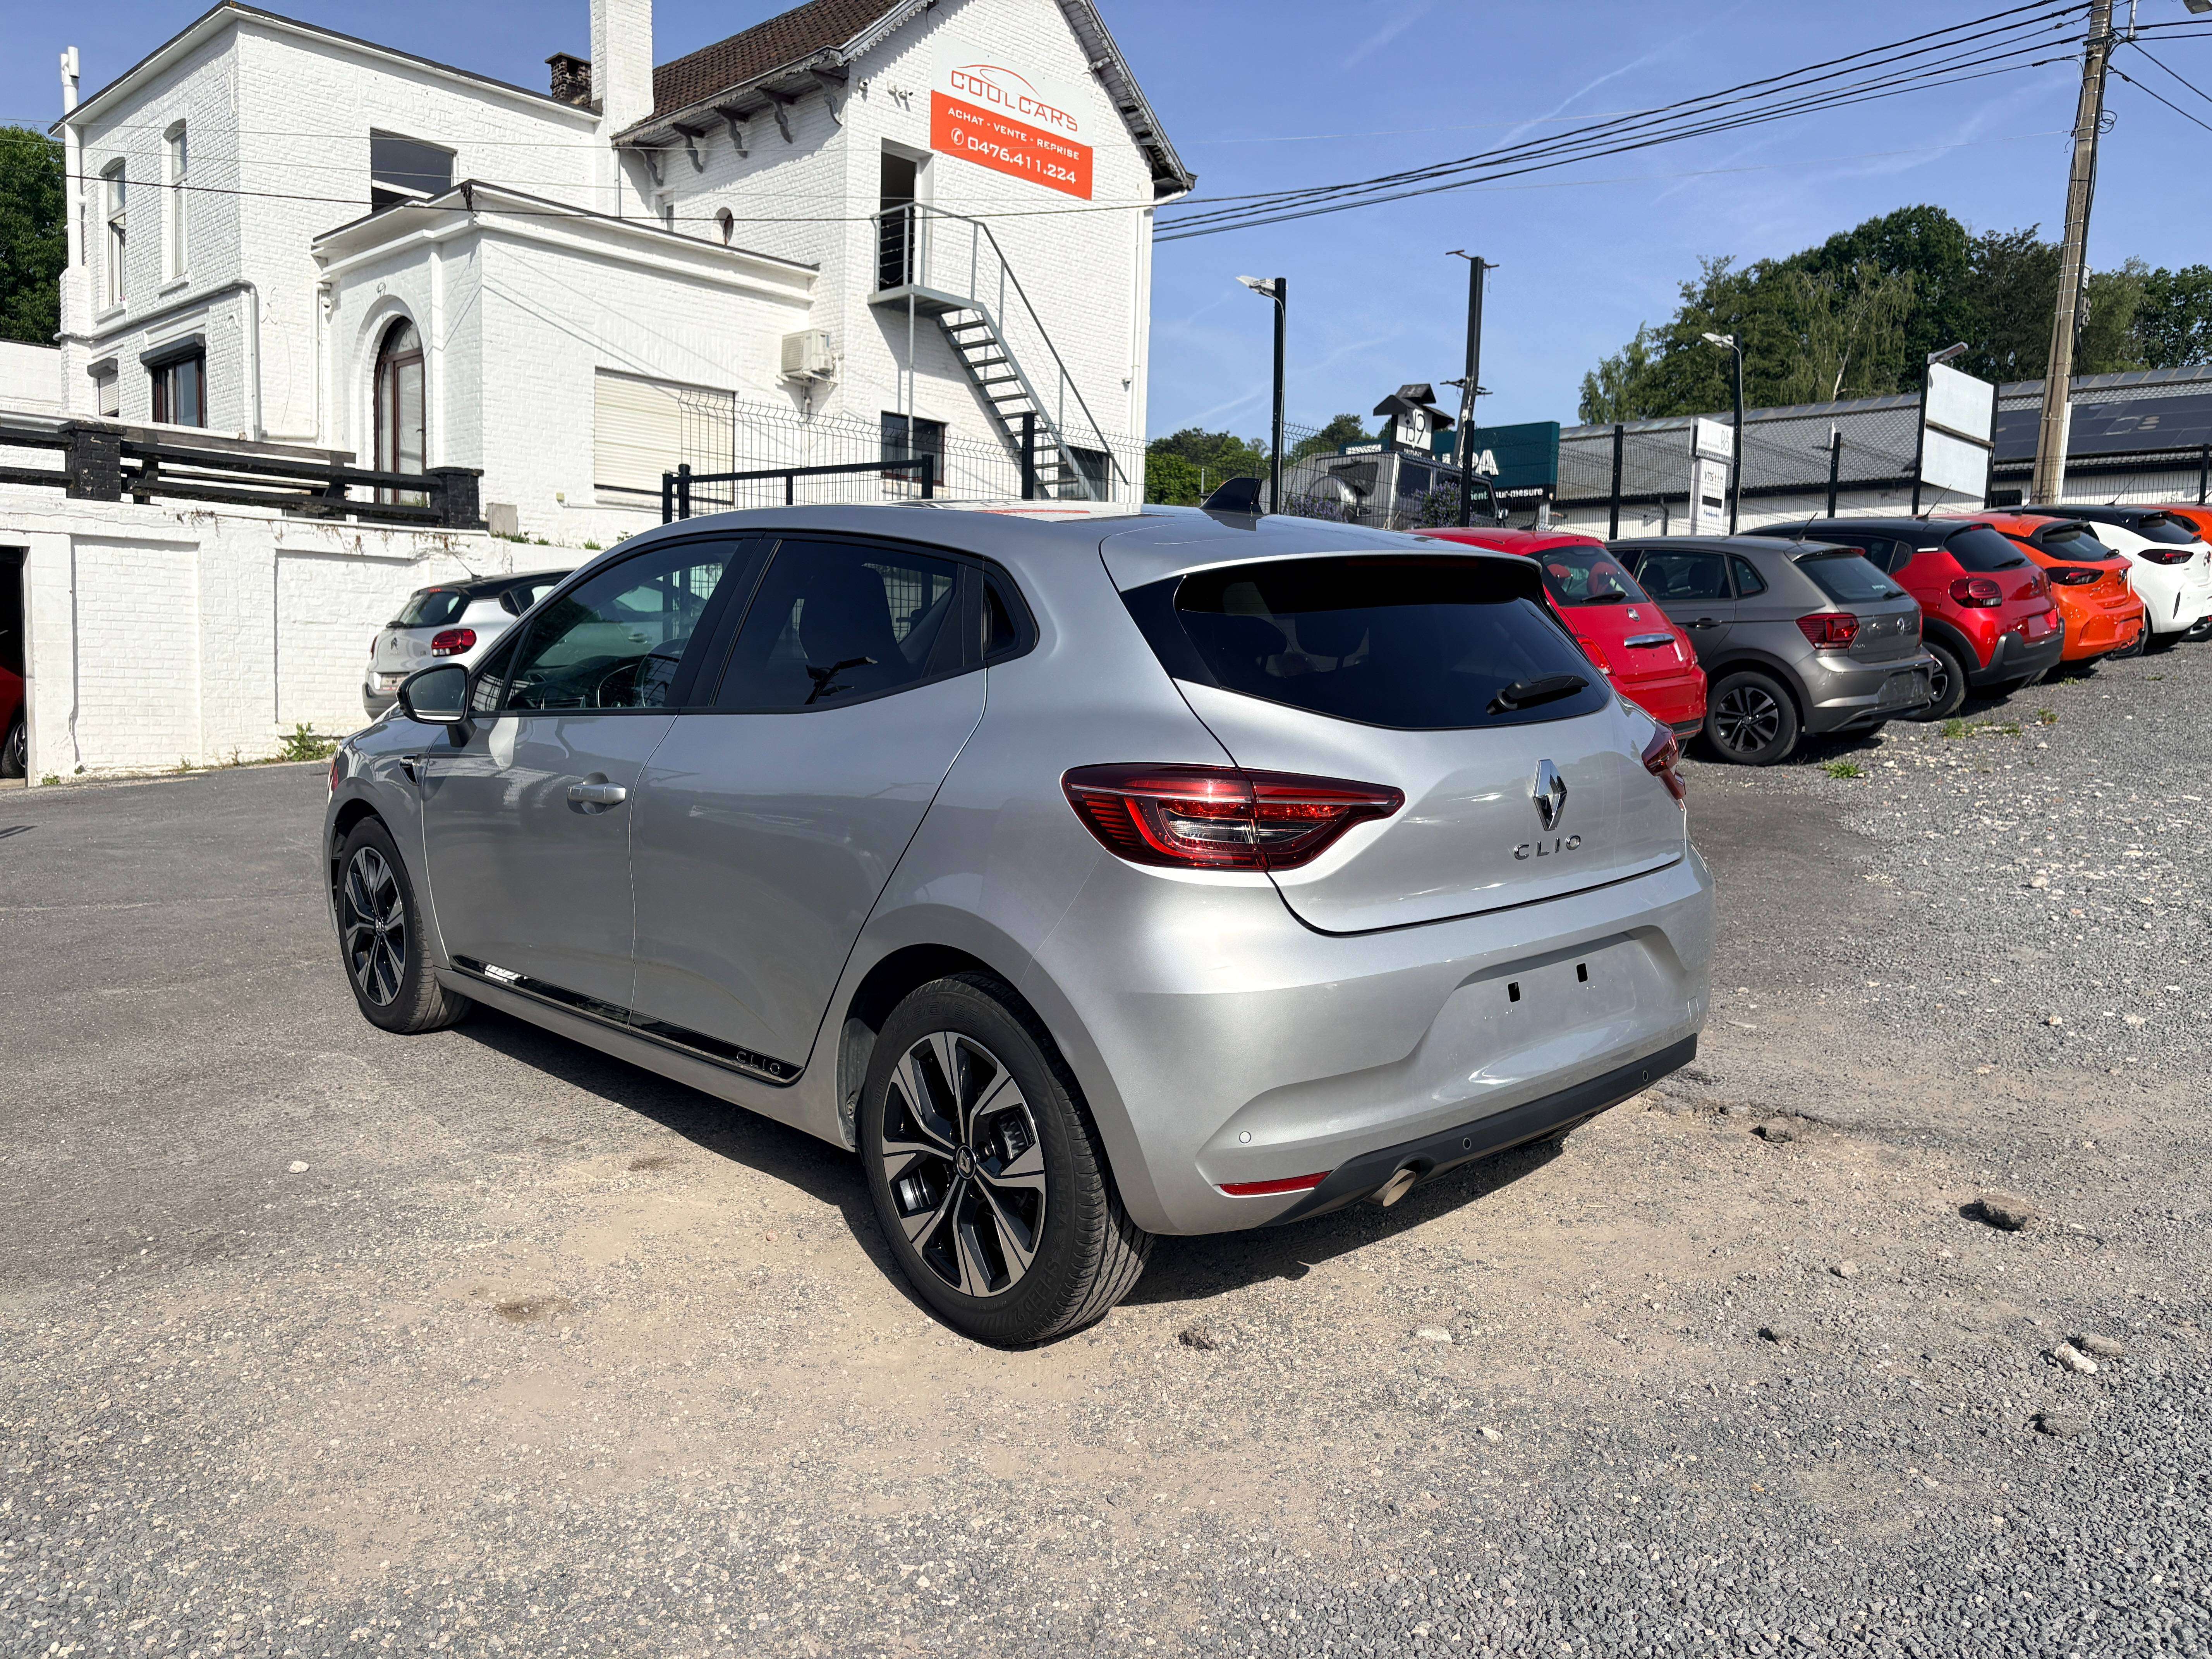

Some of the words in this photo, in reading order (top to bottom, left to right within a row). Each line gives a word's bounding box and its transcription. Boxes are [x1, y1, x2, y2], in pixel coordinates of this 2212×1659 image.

[948, 107, 984, 126] ACHAT
[993, 122, 1027, 142] VENTE
[1037, 138, 1079, 160] REPRISE
[967, 136, 1076, 184] 0476.411.224
[1513, 834, 1581, 860] CLIO
[736, 1051, 781, 1075] CLIO
[1051, 1154, 1069, 1230] ULTRA
[1024, 1256, 1060, 1314] SPEED
